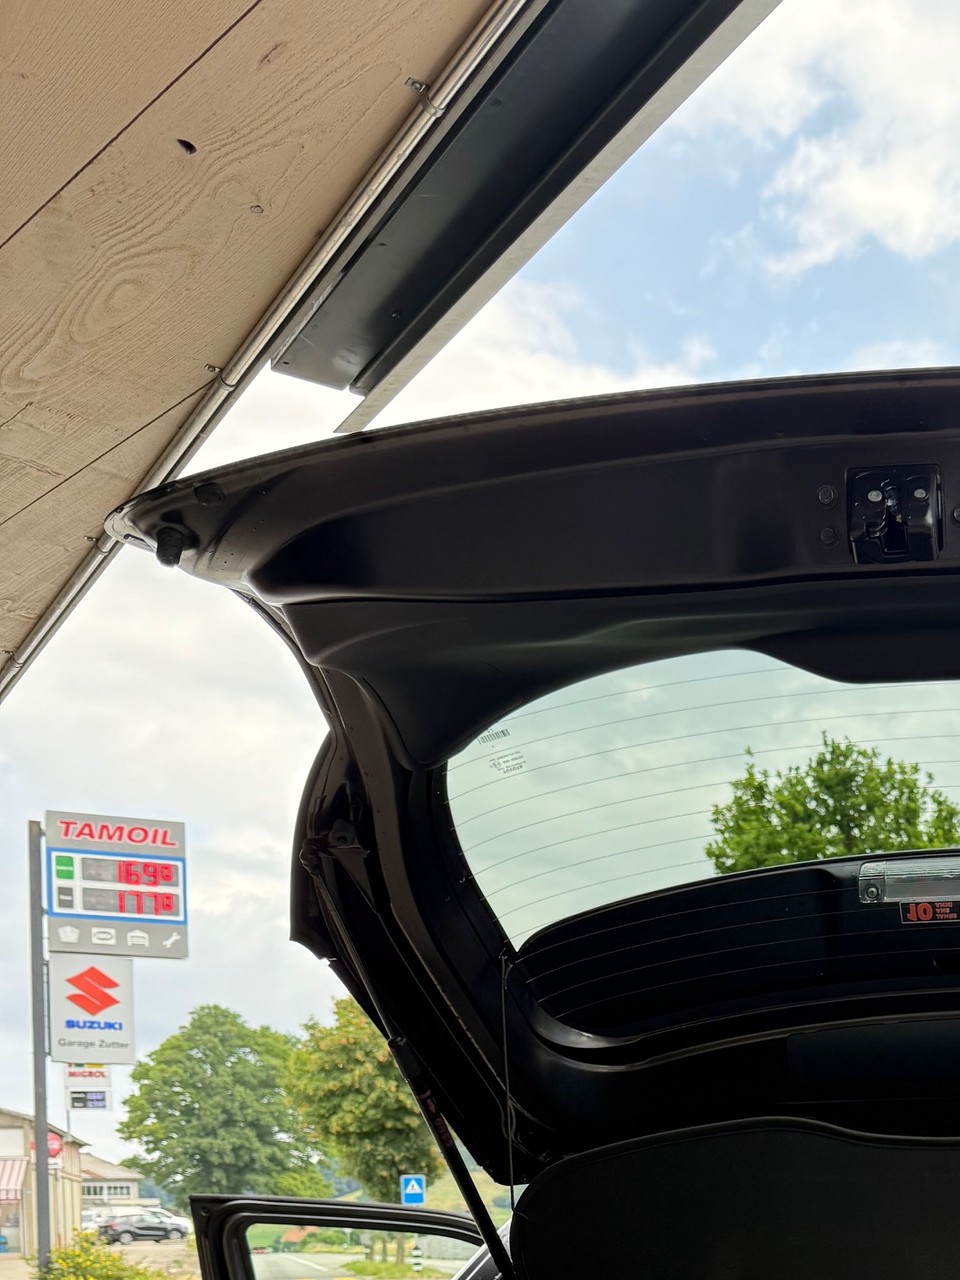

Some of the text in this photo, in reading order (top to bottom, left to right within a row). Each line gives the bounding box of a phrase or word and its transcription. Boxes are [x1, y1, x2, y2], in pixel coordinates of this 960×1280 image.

[59, 820, 177, 847] TAMOIL
[65, 1019, 123, 1031] SUZUKI
[58, 1038, 130, 1049] Garage Zutter
